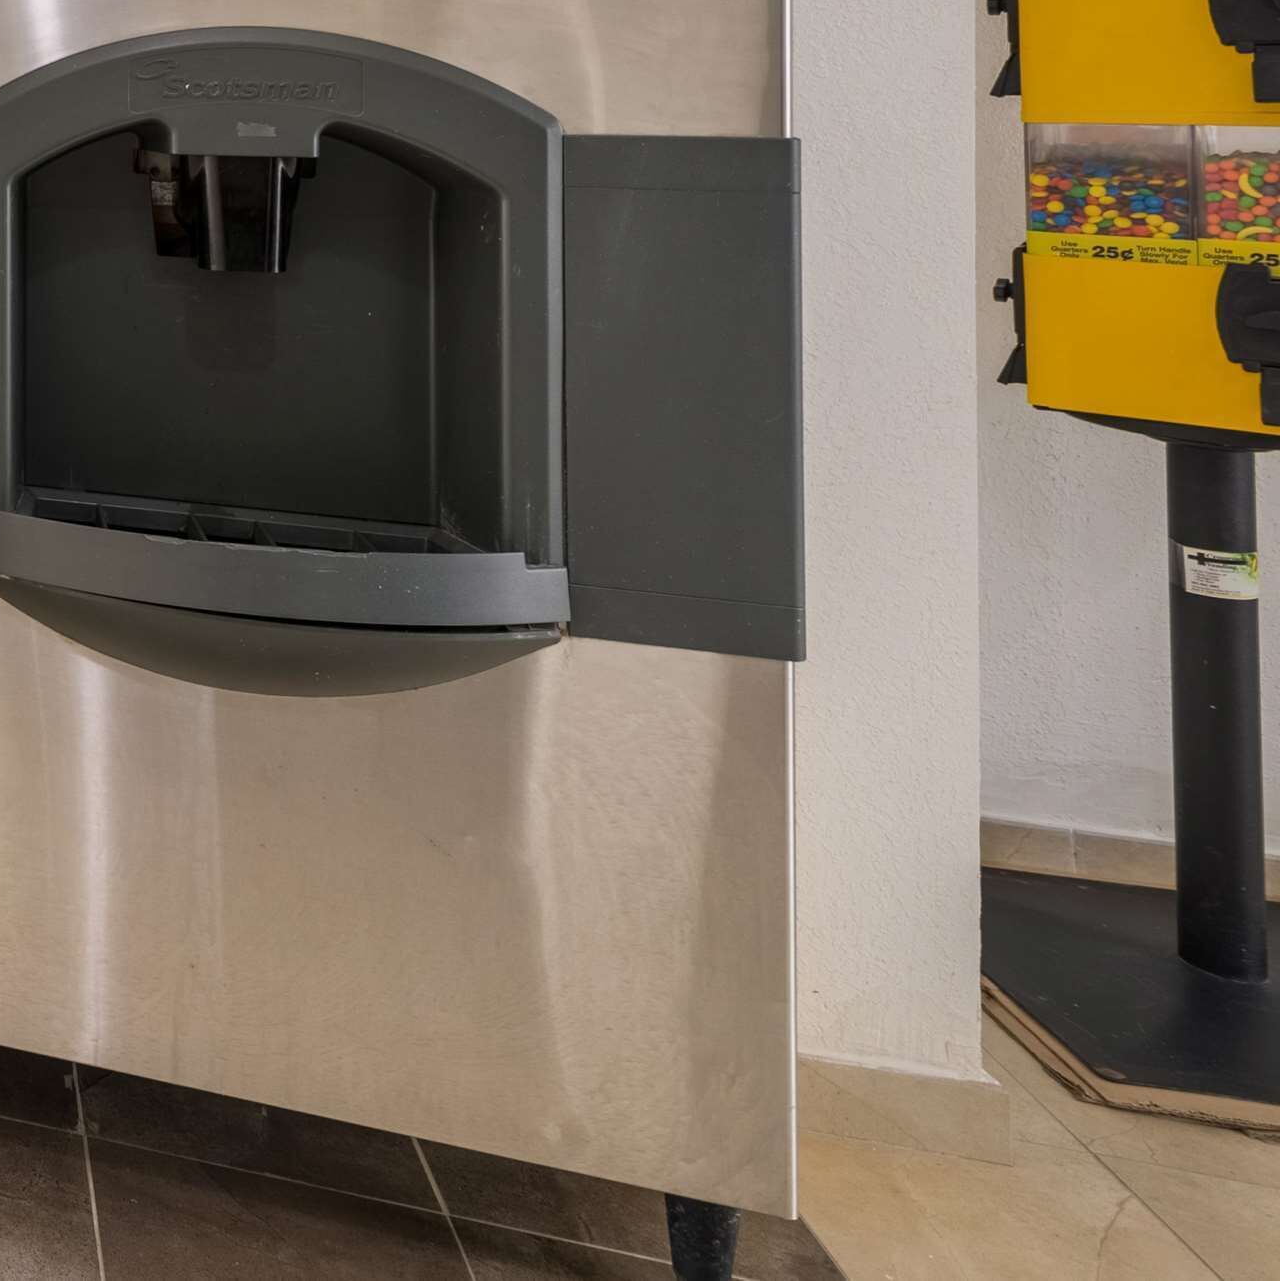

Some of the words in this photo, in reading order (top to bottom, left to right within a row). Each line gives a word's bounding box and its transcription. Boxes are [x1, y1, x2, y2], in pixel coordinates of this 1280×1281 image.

[162, 77, 339, 102] Scotsman
[1050, 245, 1089, 254] Quarters
[1091, 245, 1134, 262] 25¢
[1136, 245, 1157, 253] Turn
[1159, 246, 1192, 254] Handle
[1139, 251, 1170, 261] Slowly
[1202, 252, 1245, 261] Quarters
